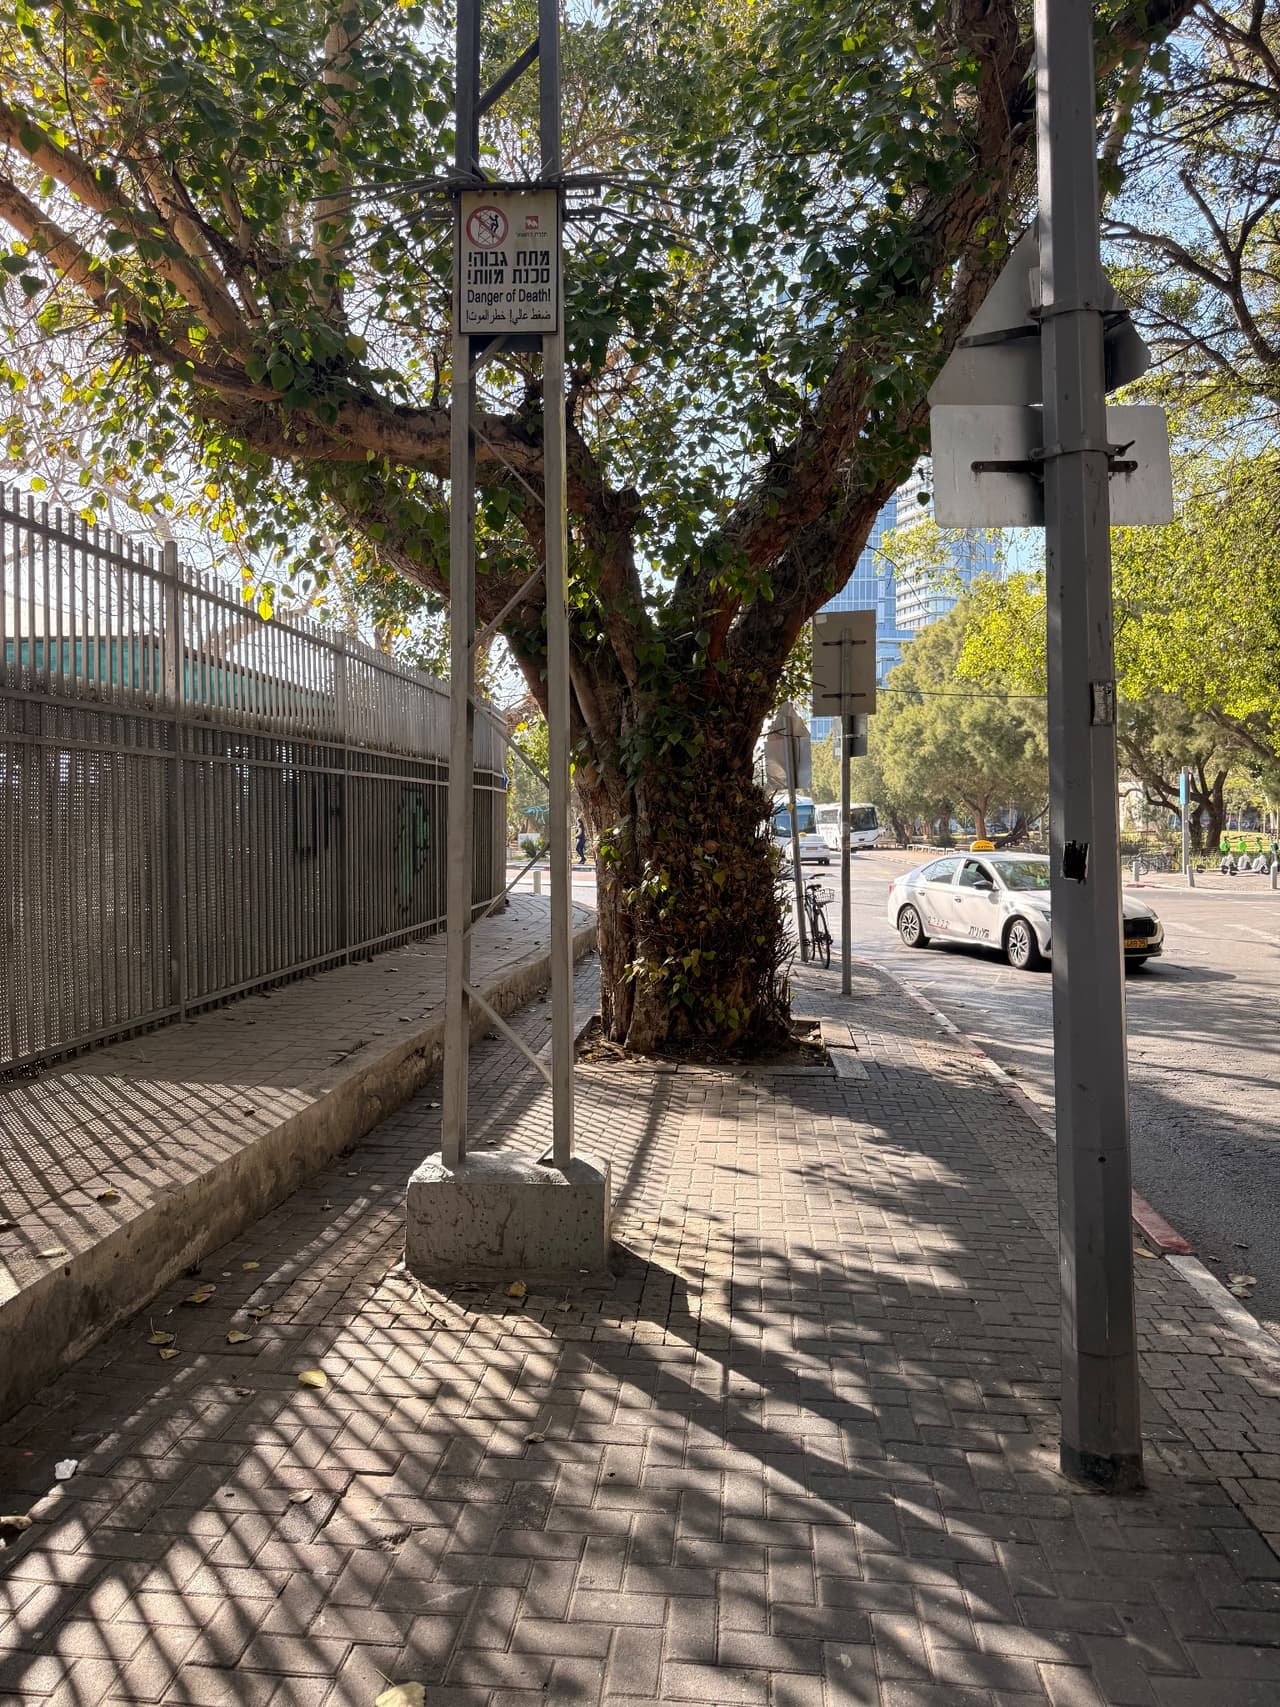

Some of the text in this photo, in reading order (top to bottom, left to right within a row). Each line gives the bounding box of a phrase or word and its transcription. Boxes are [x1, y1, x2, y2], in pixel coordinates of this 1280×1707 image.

[468, 251, 550, 267] מתח גבוה!
[467, 268, 550, 285] סכנת מוות!
[467, 288, 551, 306] Danger of Death!
[489, 308, 506, 325] خطر
[530, 307, 552, 320] ضغط
